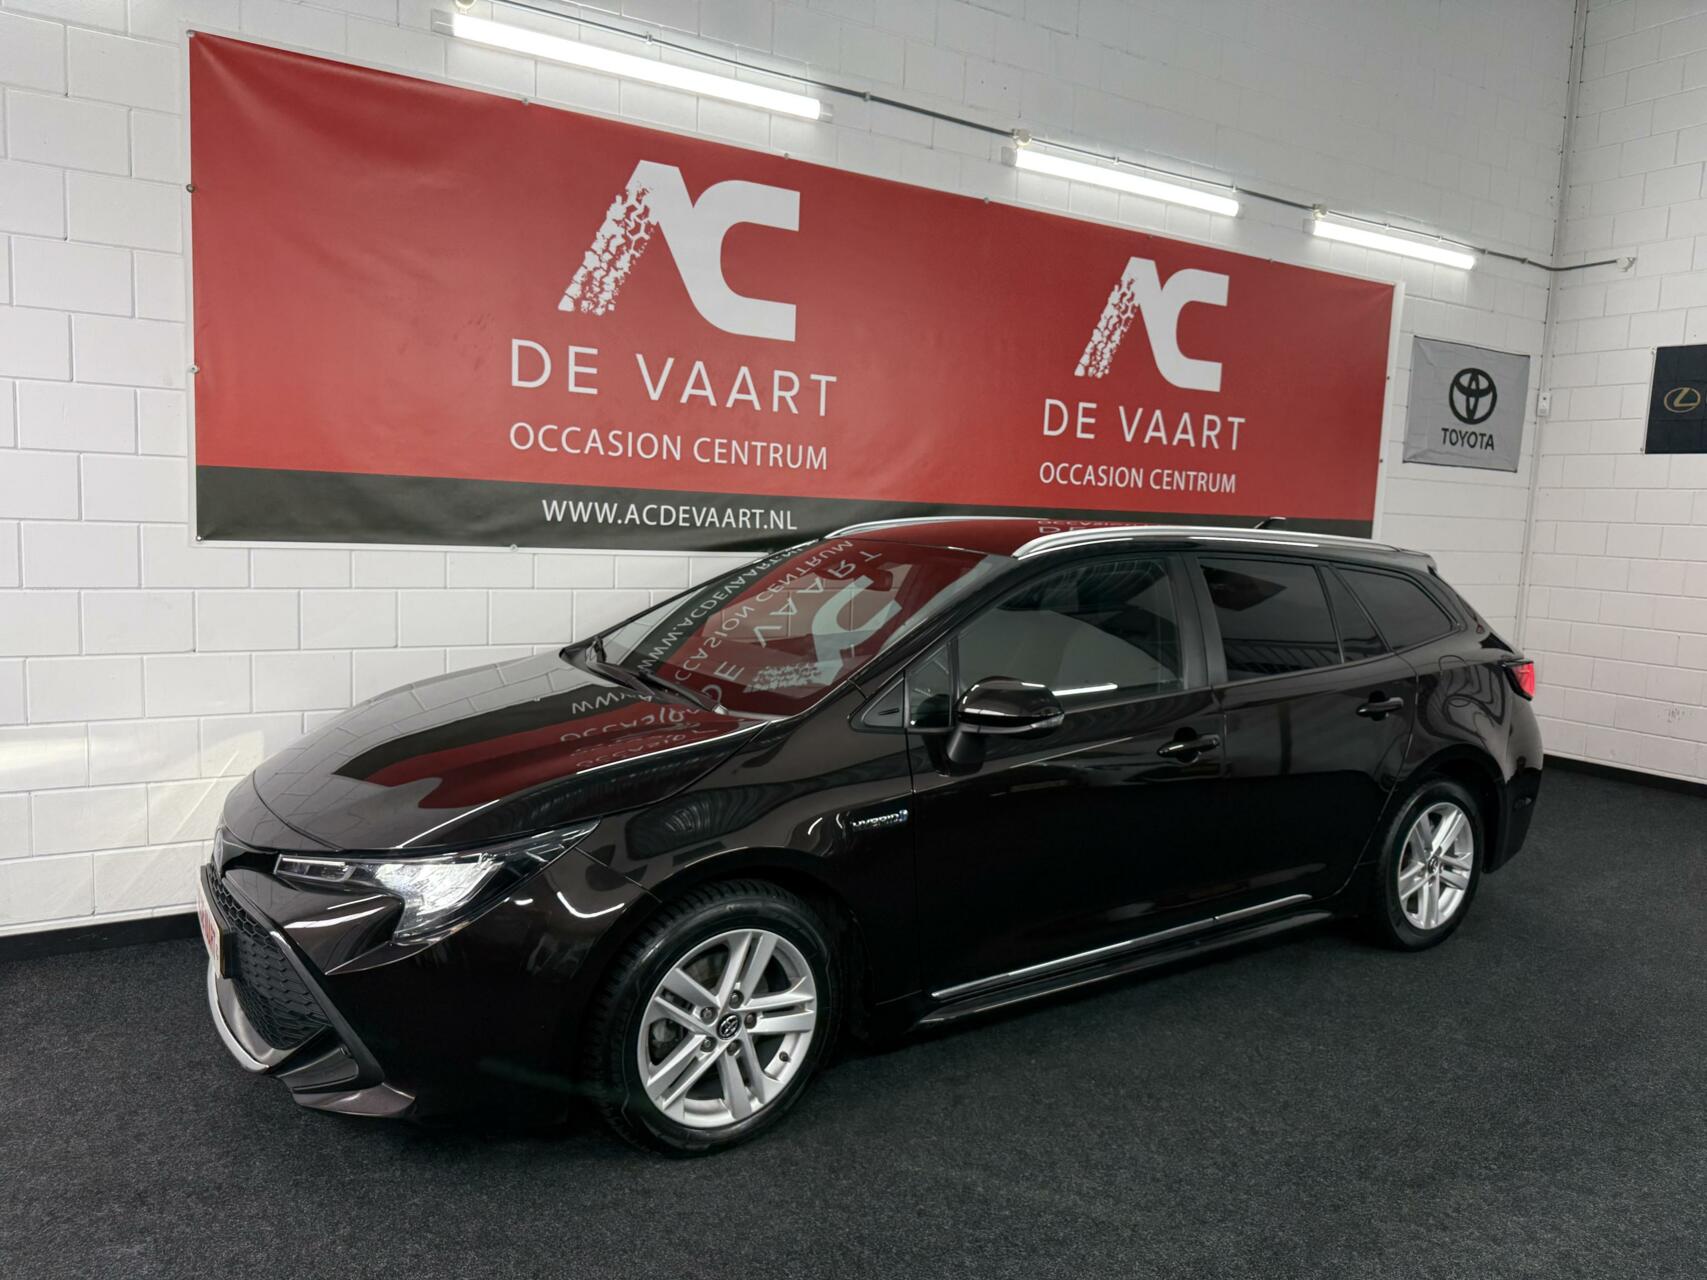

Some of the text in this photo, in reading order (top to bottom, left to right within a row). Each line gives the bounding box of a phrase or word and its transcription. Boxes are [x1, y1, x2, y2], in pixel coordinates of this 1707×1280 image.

[557, 159, 801, 342] AC
[511, 338, 837, 417] DE VAART
[509, 422, 827, 470] OCCASION CENTRUM
[1043, 398, 1246, 450] DE VAART
[1441, 427, 1495, 451] TOYOTA
[1039, 461, 1236, 493] OCCASION CENTRUM
[541, 499, 798, 530] WWW.ACDEVAART.NL
